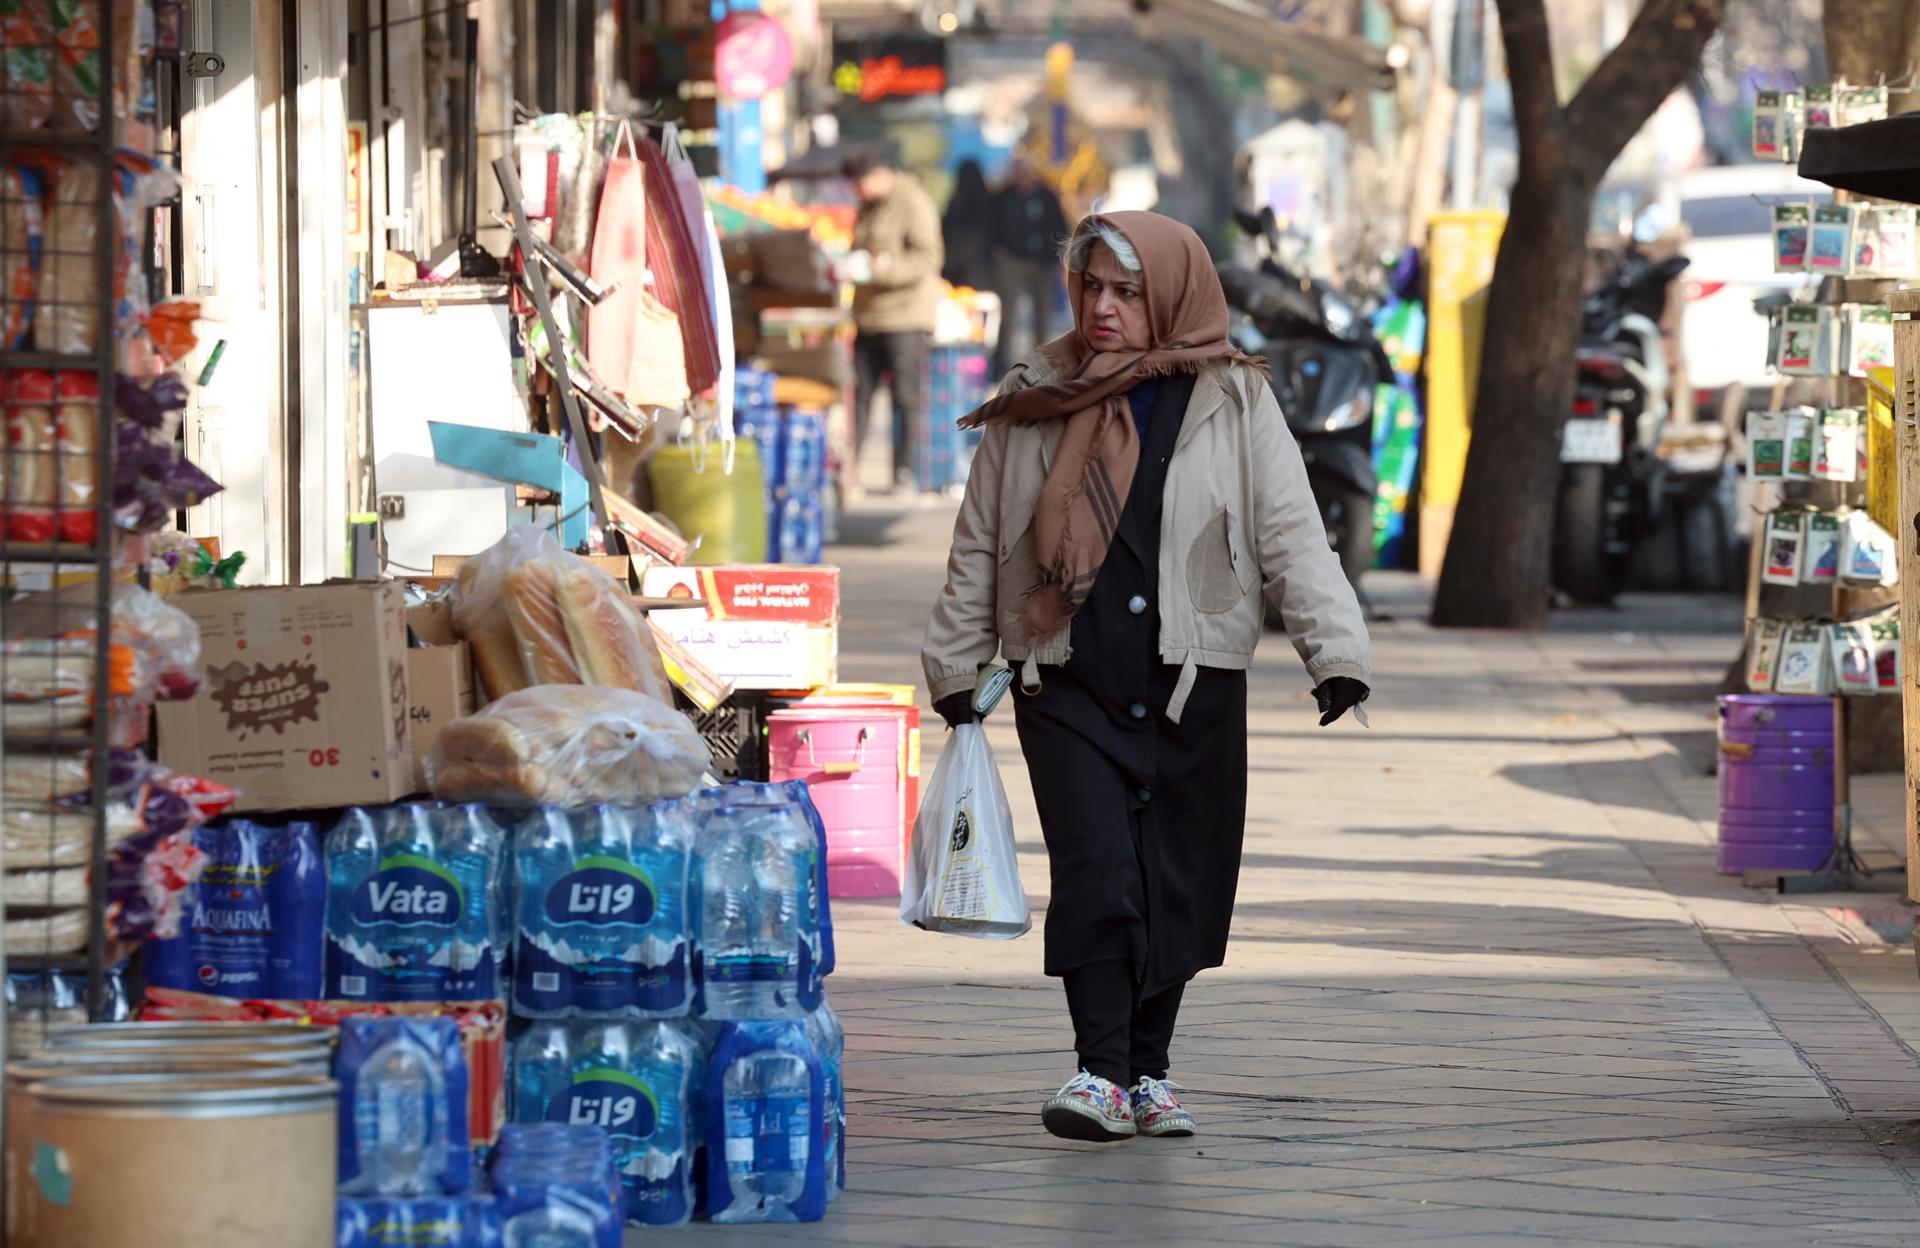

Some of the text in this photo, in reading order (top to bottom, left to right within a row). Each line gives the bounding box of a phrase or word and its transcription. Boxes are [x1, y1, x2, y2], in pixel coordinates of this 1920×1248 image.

[733, 596, 810, 608] NATURAL FIGS
[237, 671, 298, 696] PUFF
[231, 684, 310, 714] SUPER
[309, 747, 340, 767] 30
[368, 881, 448, 914] Vata
[568, 883, 635, 915] واتا
[191, 901, 272, 931] AQUAFINA
[569, 1096, 637, 1128] واتا
